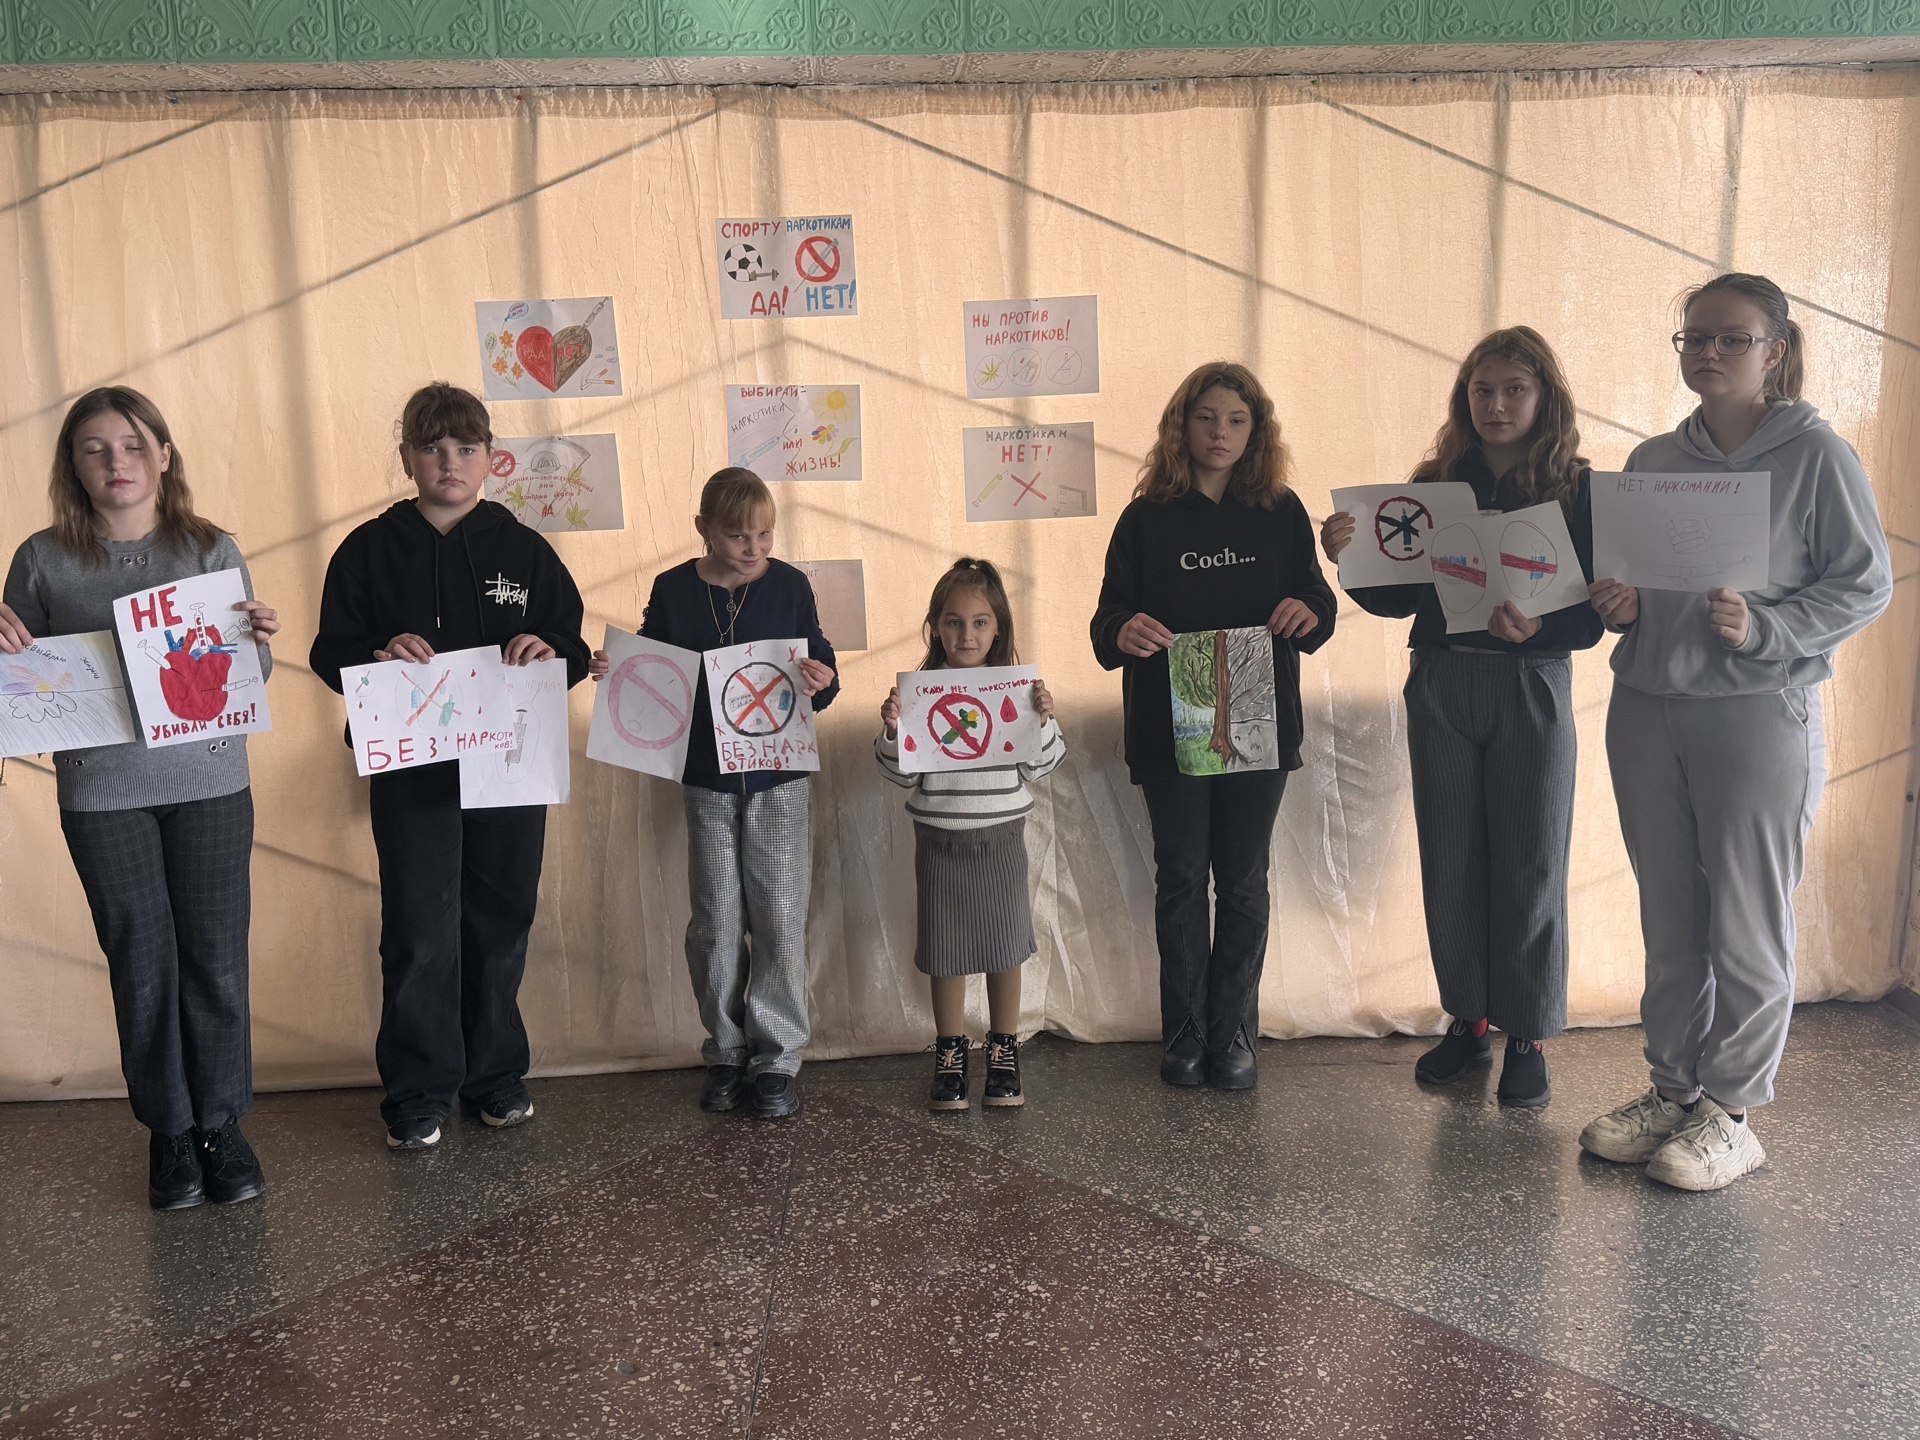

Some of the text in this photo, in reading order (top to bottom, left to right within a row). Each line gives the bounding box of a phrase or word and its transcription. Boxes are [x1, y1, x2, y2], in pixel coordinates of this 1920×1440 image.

[721, 221, 781, 239] СПОРТУ
[786, 216, 851, 233] НАРКОТИКАМ
[750, 285, 789, 316] ДА!
[805, 279, 857, 312] НЕТ!
[999, 310, 1049, 326] ПРОТИВ
[985, 319, 1071, 346] НАРКОТИКОВ!
[730, 402, 787, 433] НАРКОТИКИ
[782, 438, 803, 450] ИЛИ
[985, 429, 1068, 442] НАРКОТИКАМ
[785, 453, 842, 476] ЖИЗНЬ!
[1001, 444, 1053, 463] НЕТ!
[1616, 478, 1645, 492] НЕТ
[1179, 547, 1257, 571] Coch...
[130, 585, 183, 633] НЕ
[951, 684, 969, 694] НЕТ
[216, 702, 257, 730] СЕБЯ!
[367, 737, 438, 771] БЕЗ
[721, 739, 757, 763] БЕЗ
